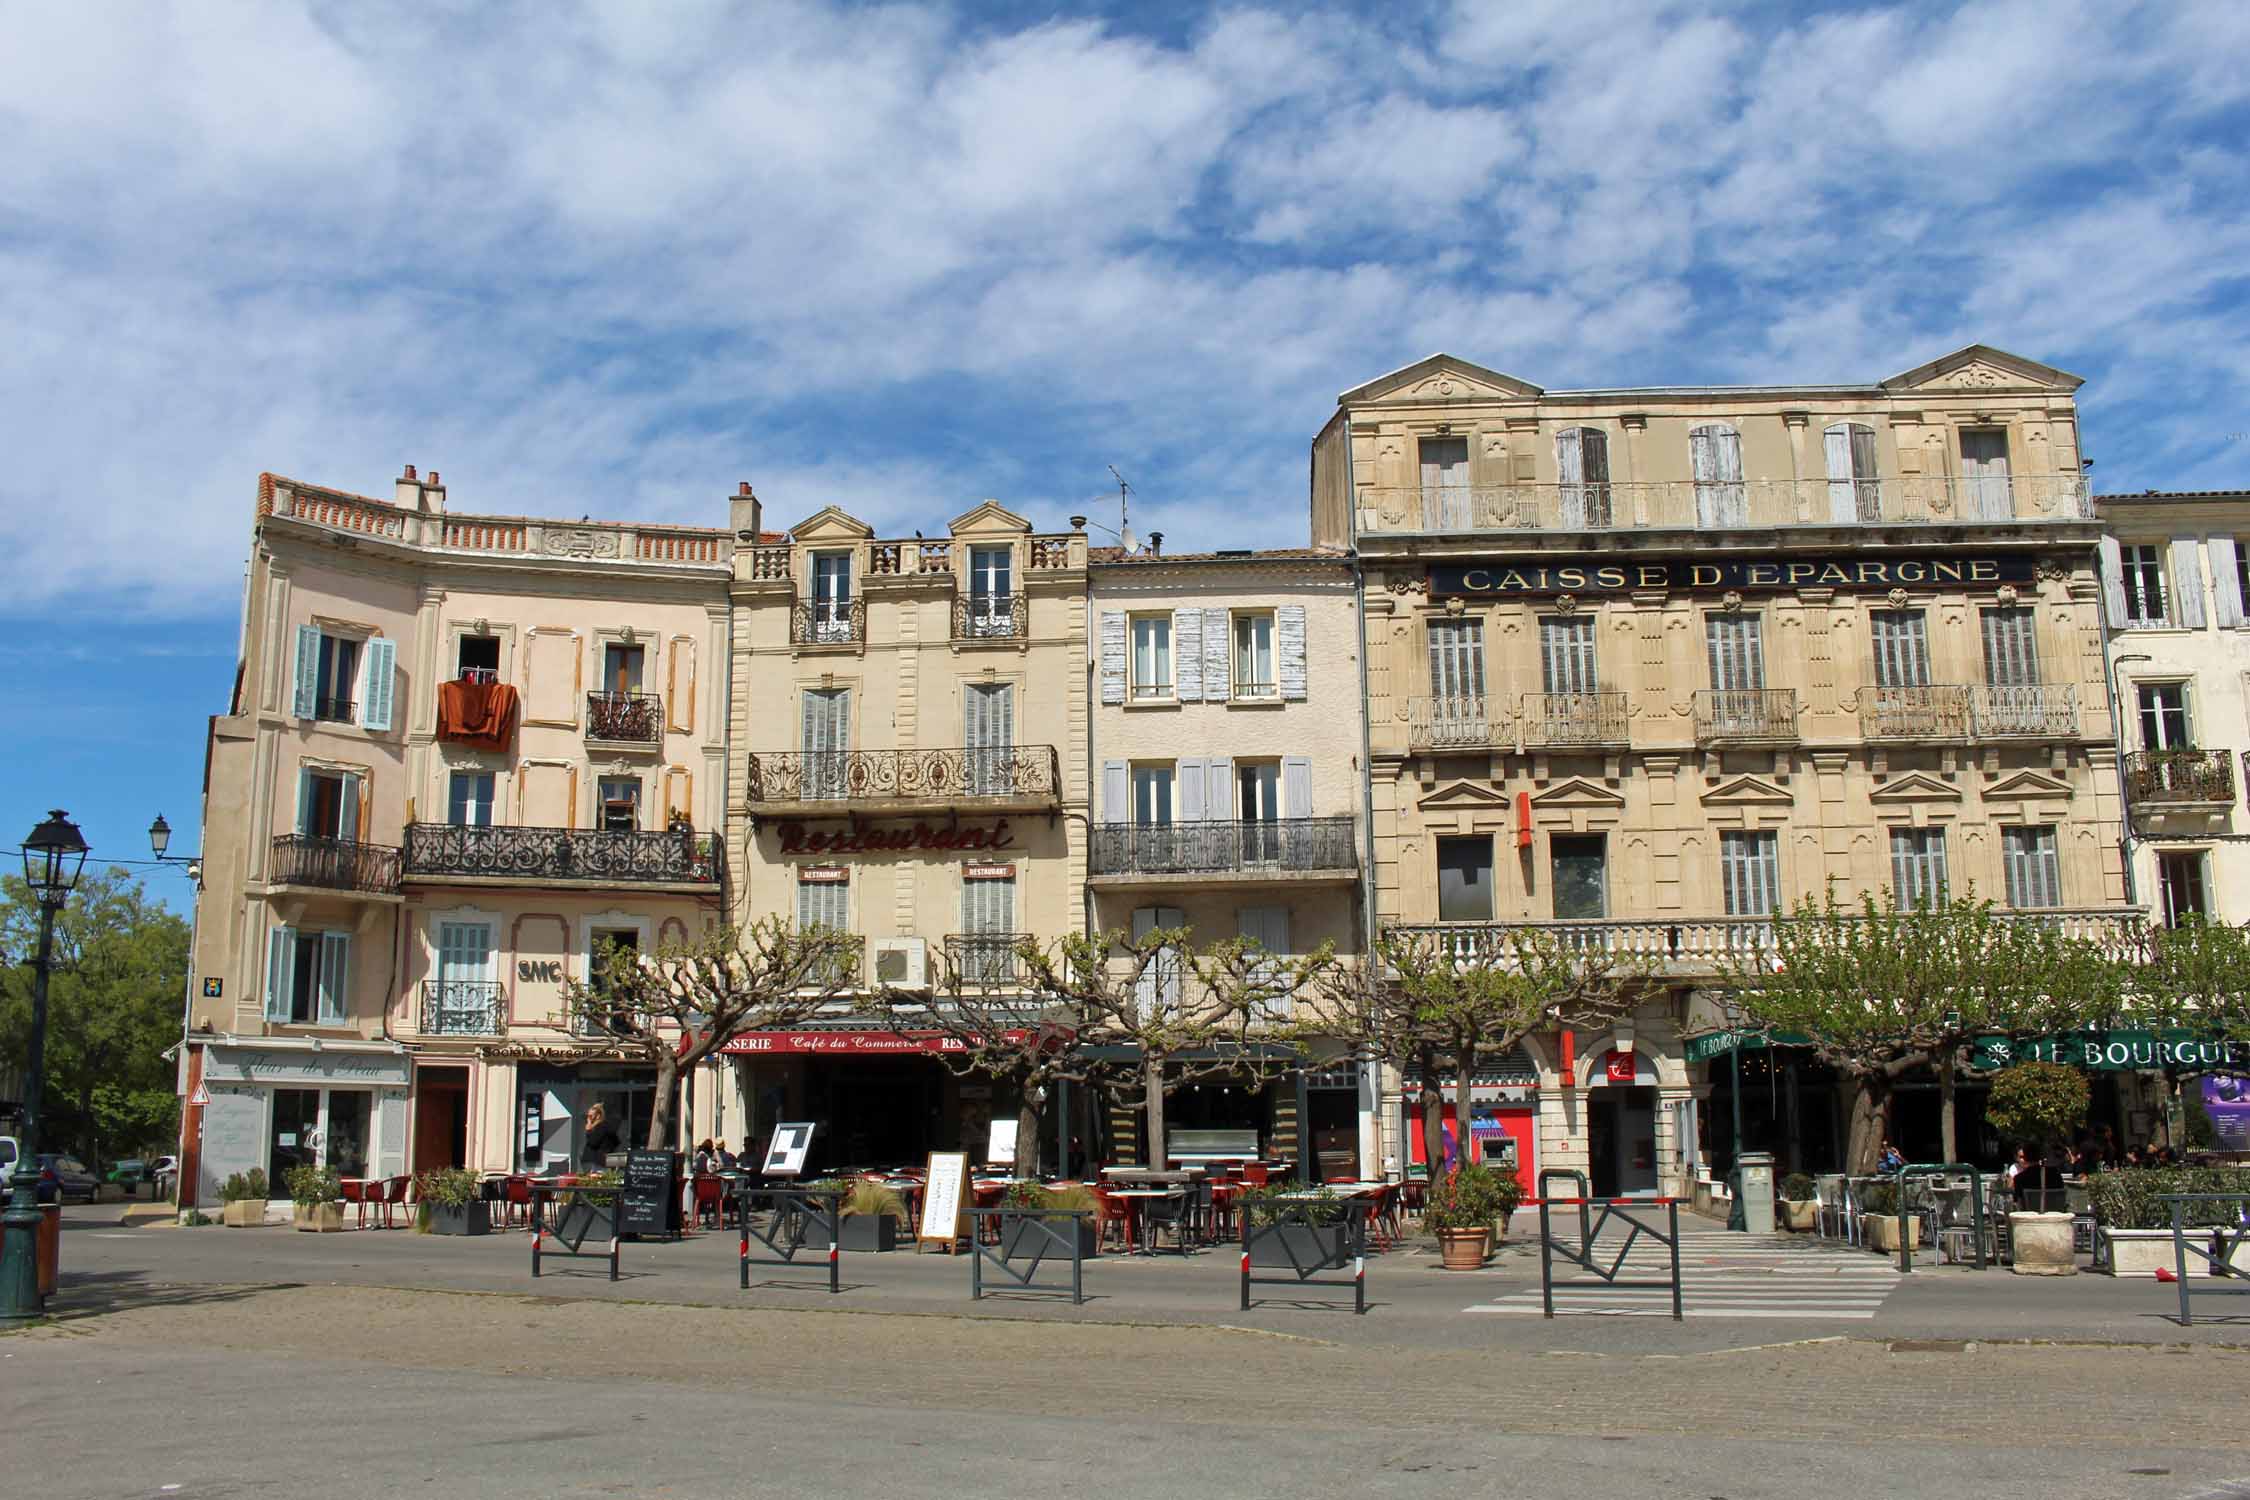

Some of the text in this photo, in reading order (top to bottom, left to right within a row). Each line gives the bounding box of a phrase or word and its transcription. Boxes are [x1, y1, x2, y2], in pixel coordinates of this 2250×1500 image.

[1463, 561, 2000, 591] CAISSE D'EPARGNE
[777, 818, 1014, 854] Restaurant
[804, 871, 842, 880] RESTAURANT
[969, 867, 1009, 876] RESTAURANT
[518, 960, 562, 983] SMC
[790, 1036, 826, 1051] Café
[830, 1037, 848, 1048] du
[851, 1036, 923, 1048] Commerce
[2035, 1042, 2067, 1064] LE
